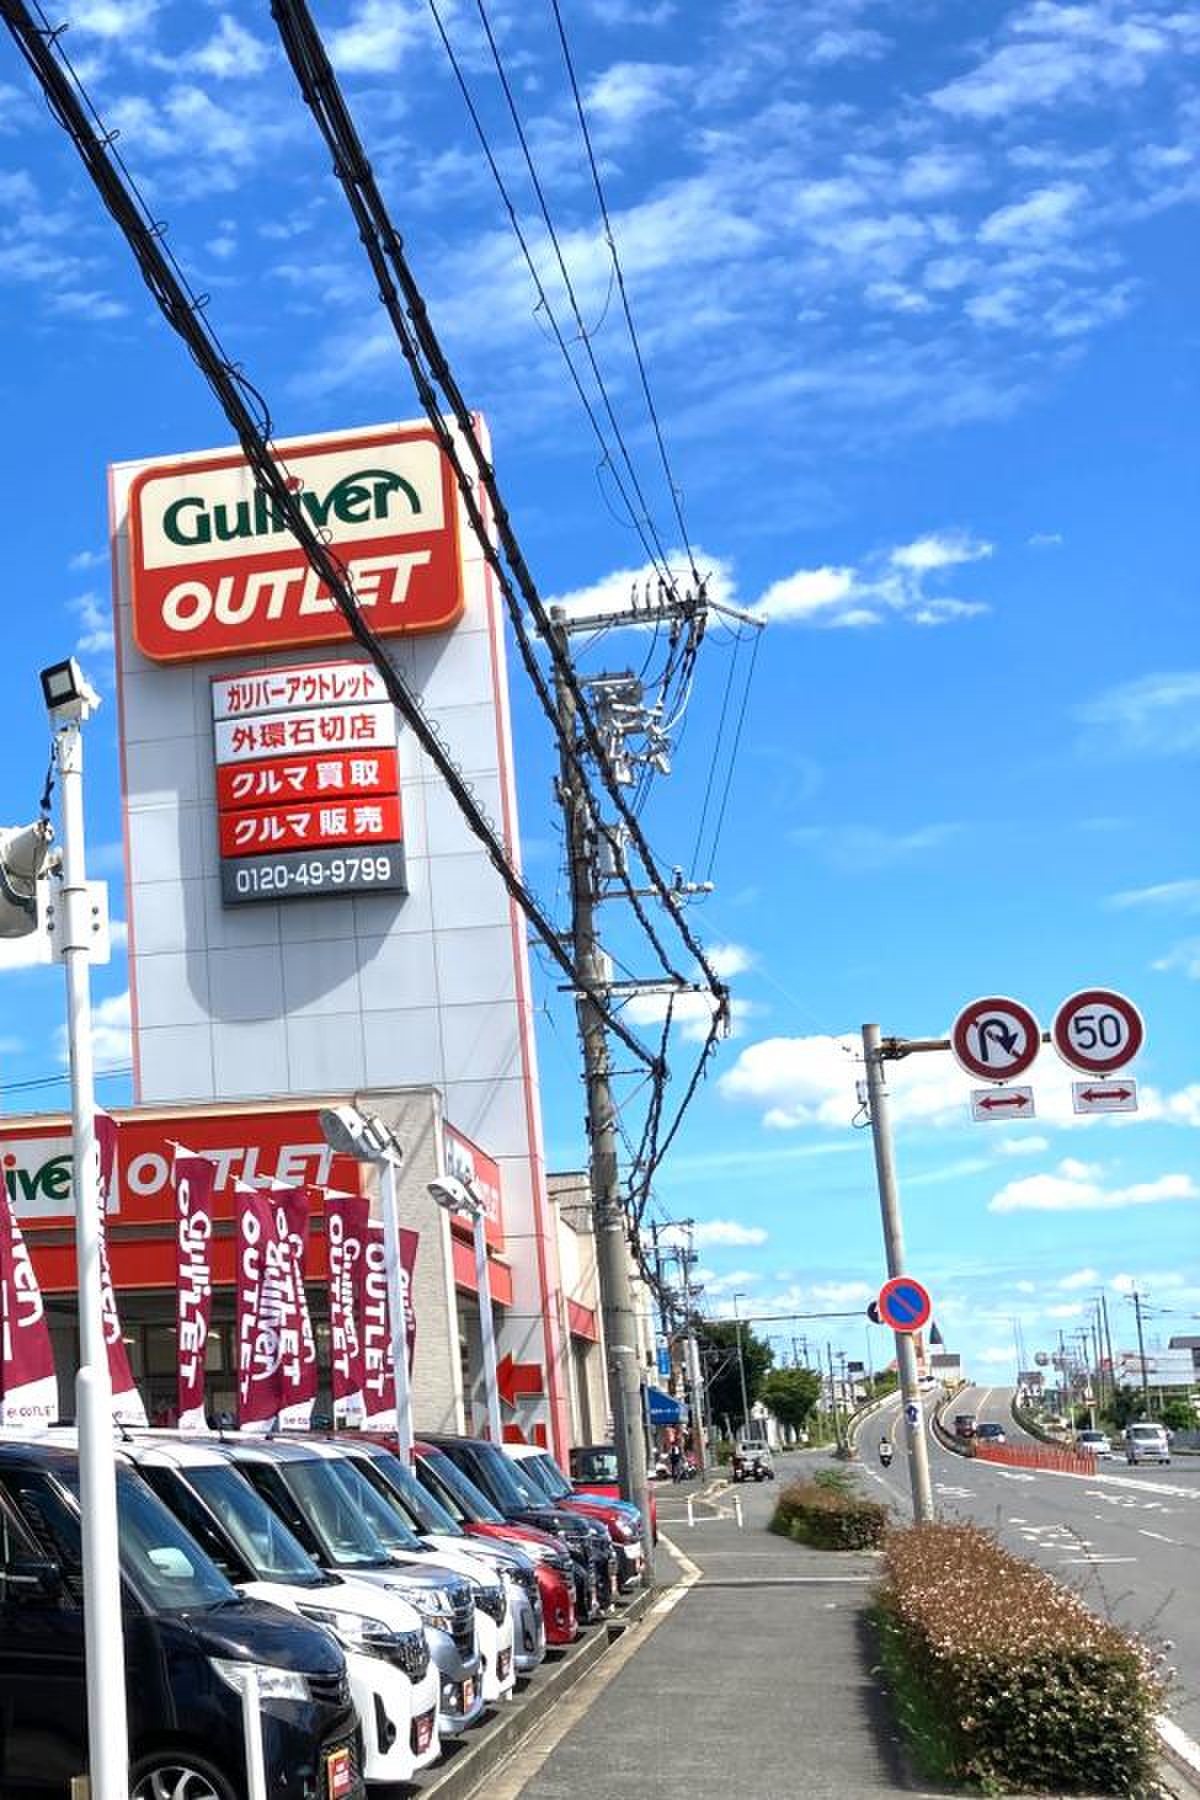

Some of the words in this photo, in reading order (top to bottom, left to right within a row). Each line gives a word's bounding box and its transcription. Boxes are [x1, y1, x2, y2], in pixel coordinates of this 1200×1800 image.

[161, 551, 431, 632] OUTLET
[227, 671, 375, 713] ガリバーアウトレット
[231, 713, 376, 752] 外環石切店
[236, 857, 391, 893] 0120-49-9799
[1072, 1014, 1122, 1051] 50
[127, 1143, 337, 1197] OTLET
[365, 1242, 388, 1398] OUTLET
